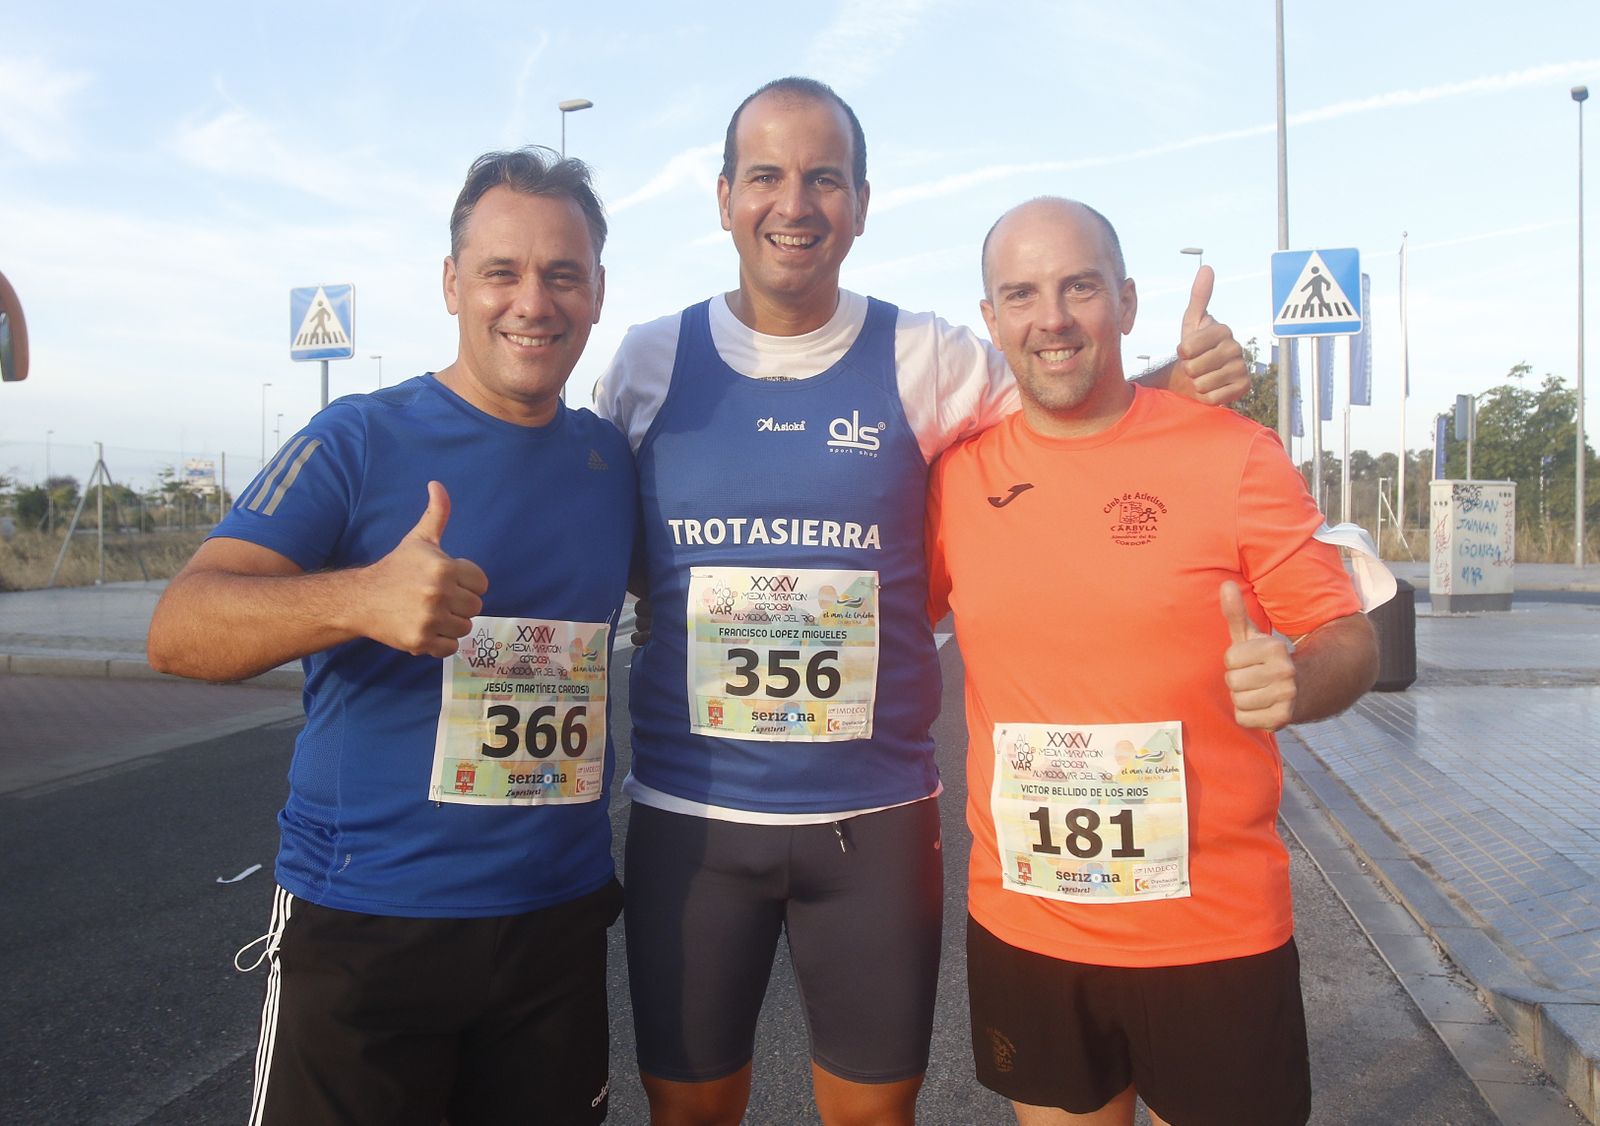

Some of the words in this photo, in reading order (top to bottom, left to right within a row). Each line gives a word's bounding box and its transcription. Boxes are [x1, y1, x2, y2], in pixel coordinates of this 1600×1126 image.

[1103, 497, 1120, 514] Club
[1122, 493, 1132, 501] de
[1134, 492, 1167, 514] Atletismo
[668, 518, 881, 550] TROTASIERRA
[750, 576, 799, 591] XXXV
[741, 592, 766, 600] MEDIA
[769, 592, 807, 601] MARATÓN
[708, 605, 732, 615] VAR
[755, 602, 793, 611] CÓRDOBA
[733, 612, 781, 622] ALMODÓVAR
[784, 614, 799, 622] DEL
[477, 628, 493, 639] AL
[516, 625, 556, 643] XXXV
[719, 627, 768, 638] FRANCISCO
[770, 629, 799, 639] LOPEZ
[802, 630, 847, 639] MIGUELES
[472, 638, 495, 649] MO
[506, 643, 532, 653] MEDIA
[478, 648, 499, 659] DO
[468, 657, 496, 668] VAR
[725, 648, 841, 699] 356
[484, 681, 513, 693] JESÚS
[515, 683, 557, 694] MARTÍNEZ
[558, 684, 590, 694] CARDOSO
[481, 704, 588, 759] 366
[1047, 731, 1093, 748] XXXV
[1018, 752, 1034, 762] DO
[1039, 748, 1060, 757] MEDIA
[1064, 748, 1103, 758] MARATÓN
[1011, 760, 1032, 771] VAR
[1079, 772, 1096, 780] DEL
[1021, 784, 1049, 795] VICTOR
[1052, 787, 1087, 797] BELLIDO
[1090, 788, 1101, 797] DE
[1105, 788, 1123, 797] LOS
[1127, 787, 1149, 797] RIOS
[1029, 807, 1145, 858] 181
